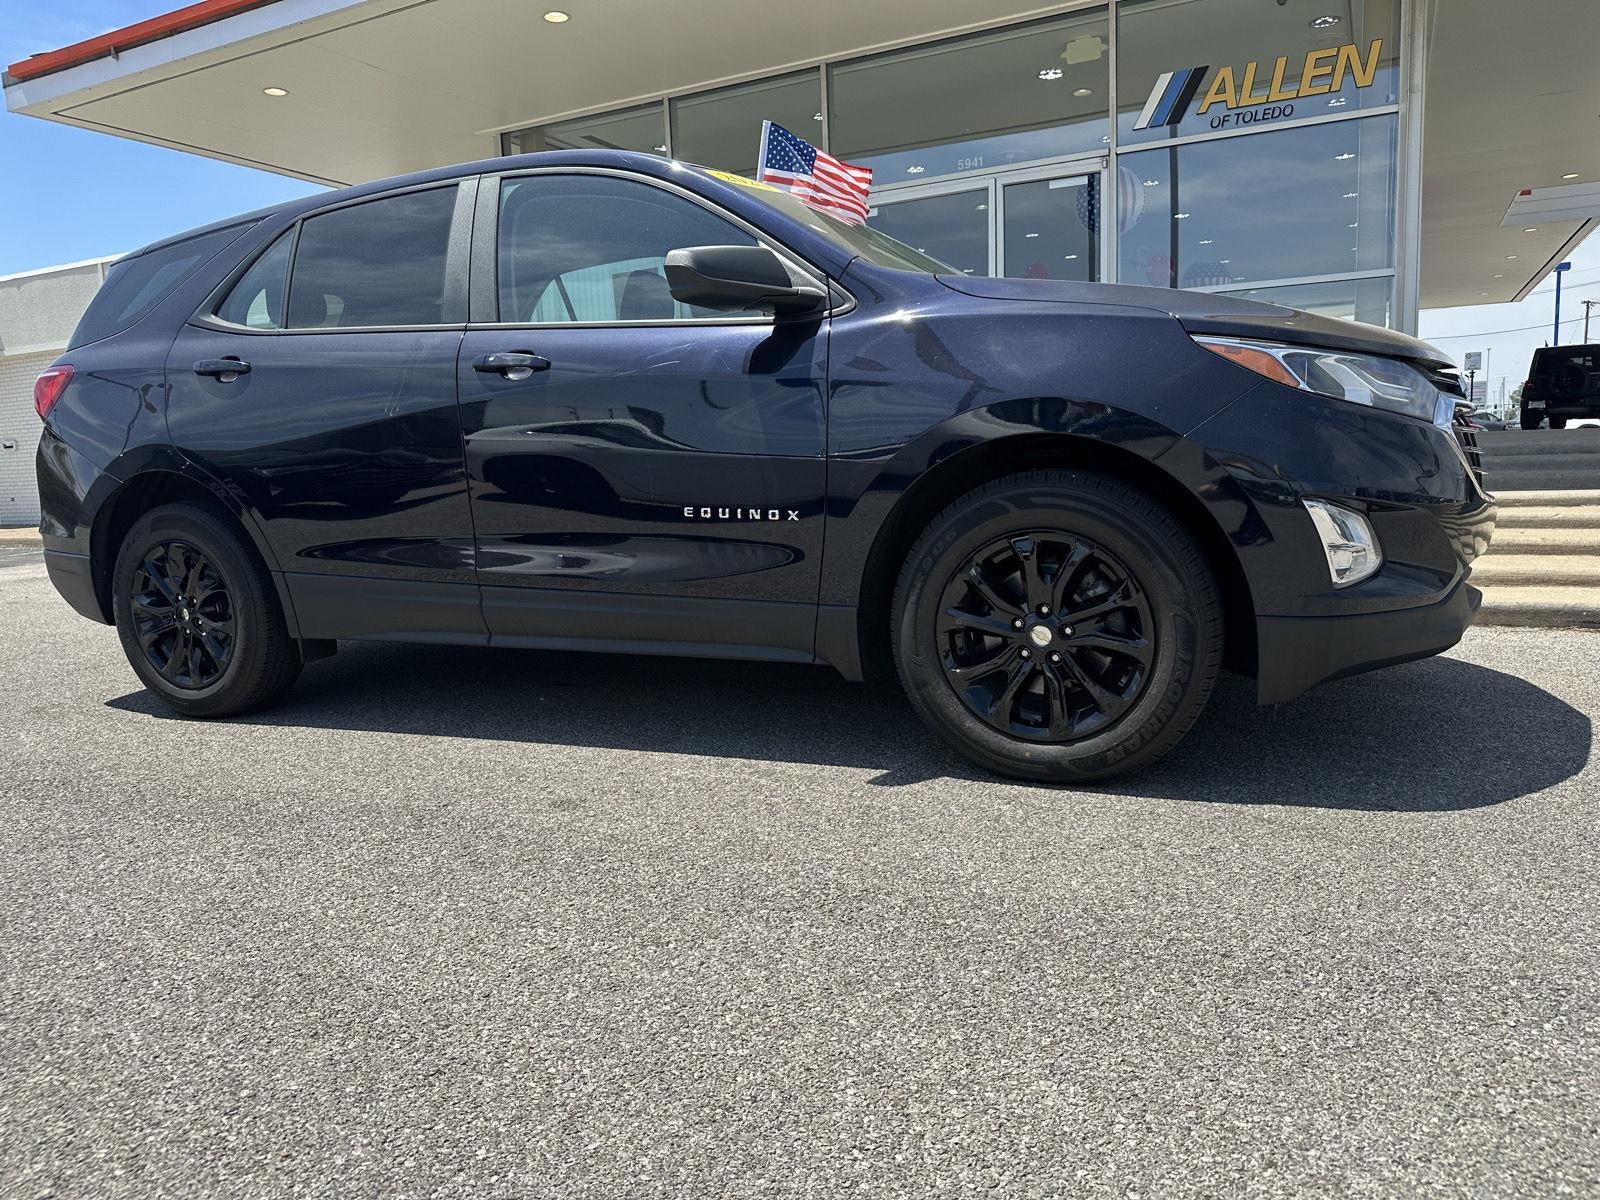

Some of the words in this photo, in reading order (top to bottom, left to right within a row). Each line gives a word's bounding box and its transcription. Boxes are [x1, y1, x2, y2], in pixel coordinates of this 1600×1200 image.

[1196, 38, 1383, 115] ALLEN
[1210, 114, 1231, 129] OF
[1234, 104, 1294, 125] TOLEDO
[957, 155, 983, 170] 5941
[683, 506, 800, 521] EQUINOX
